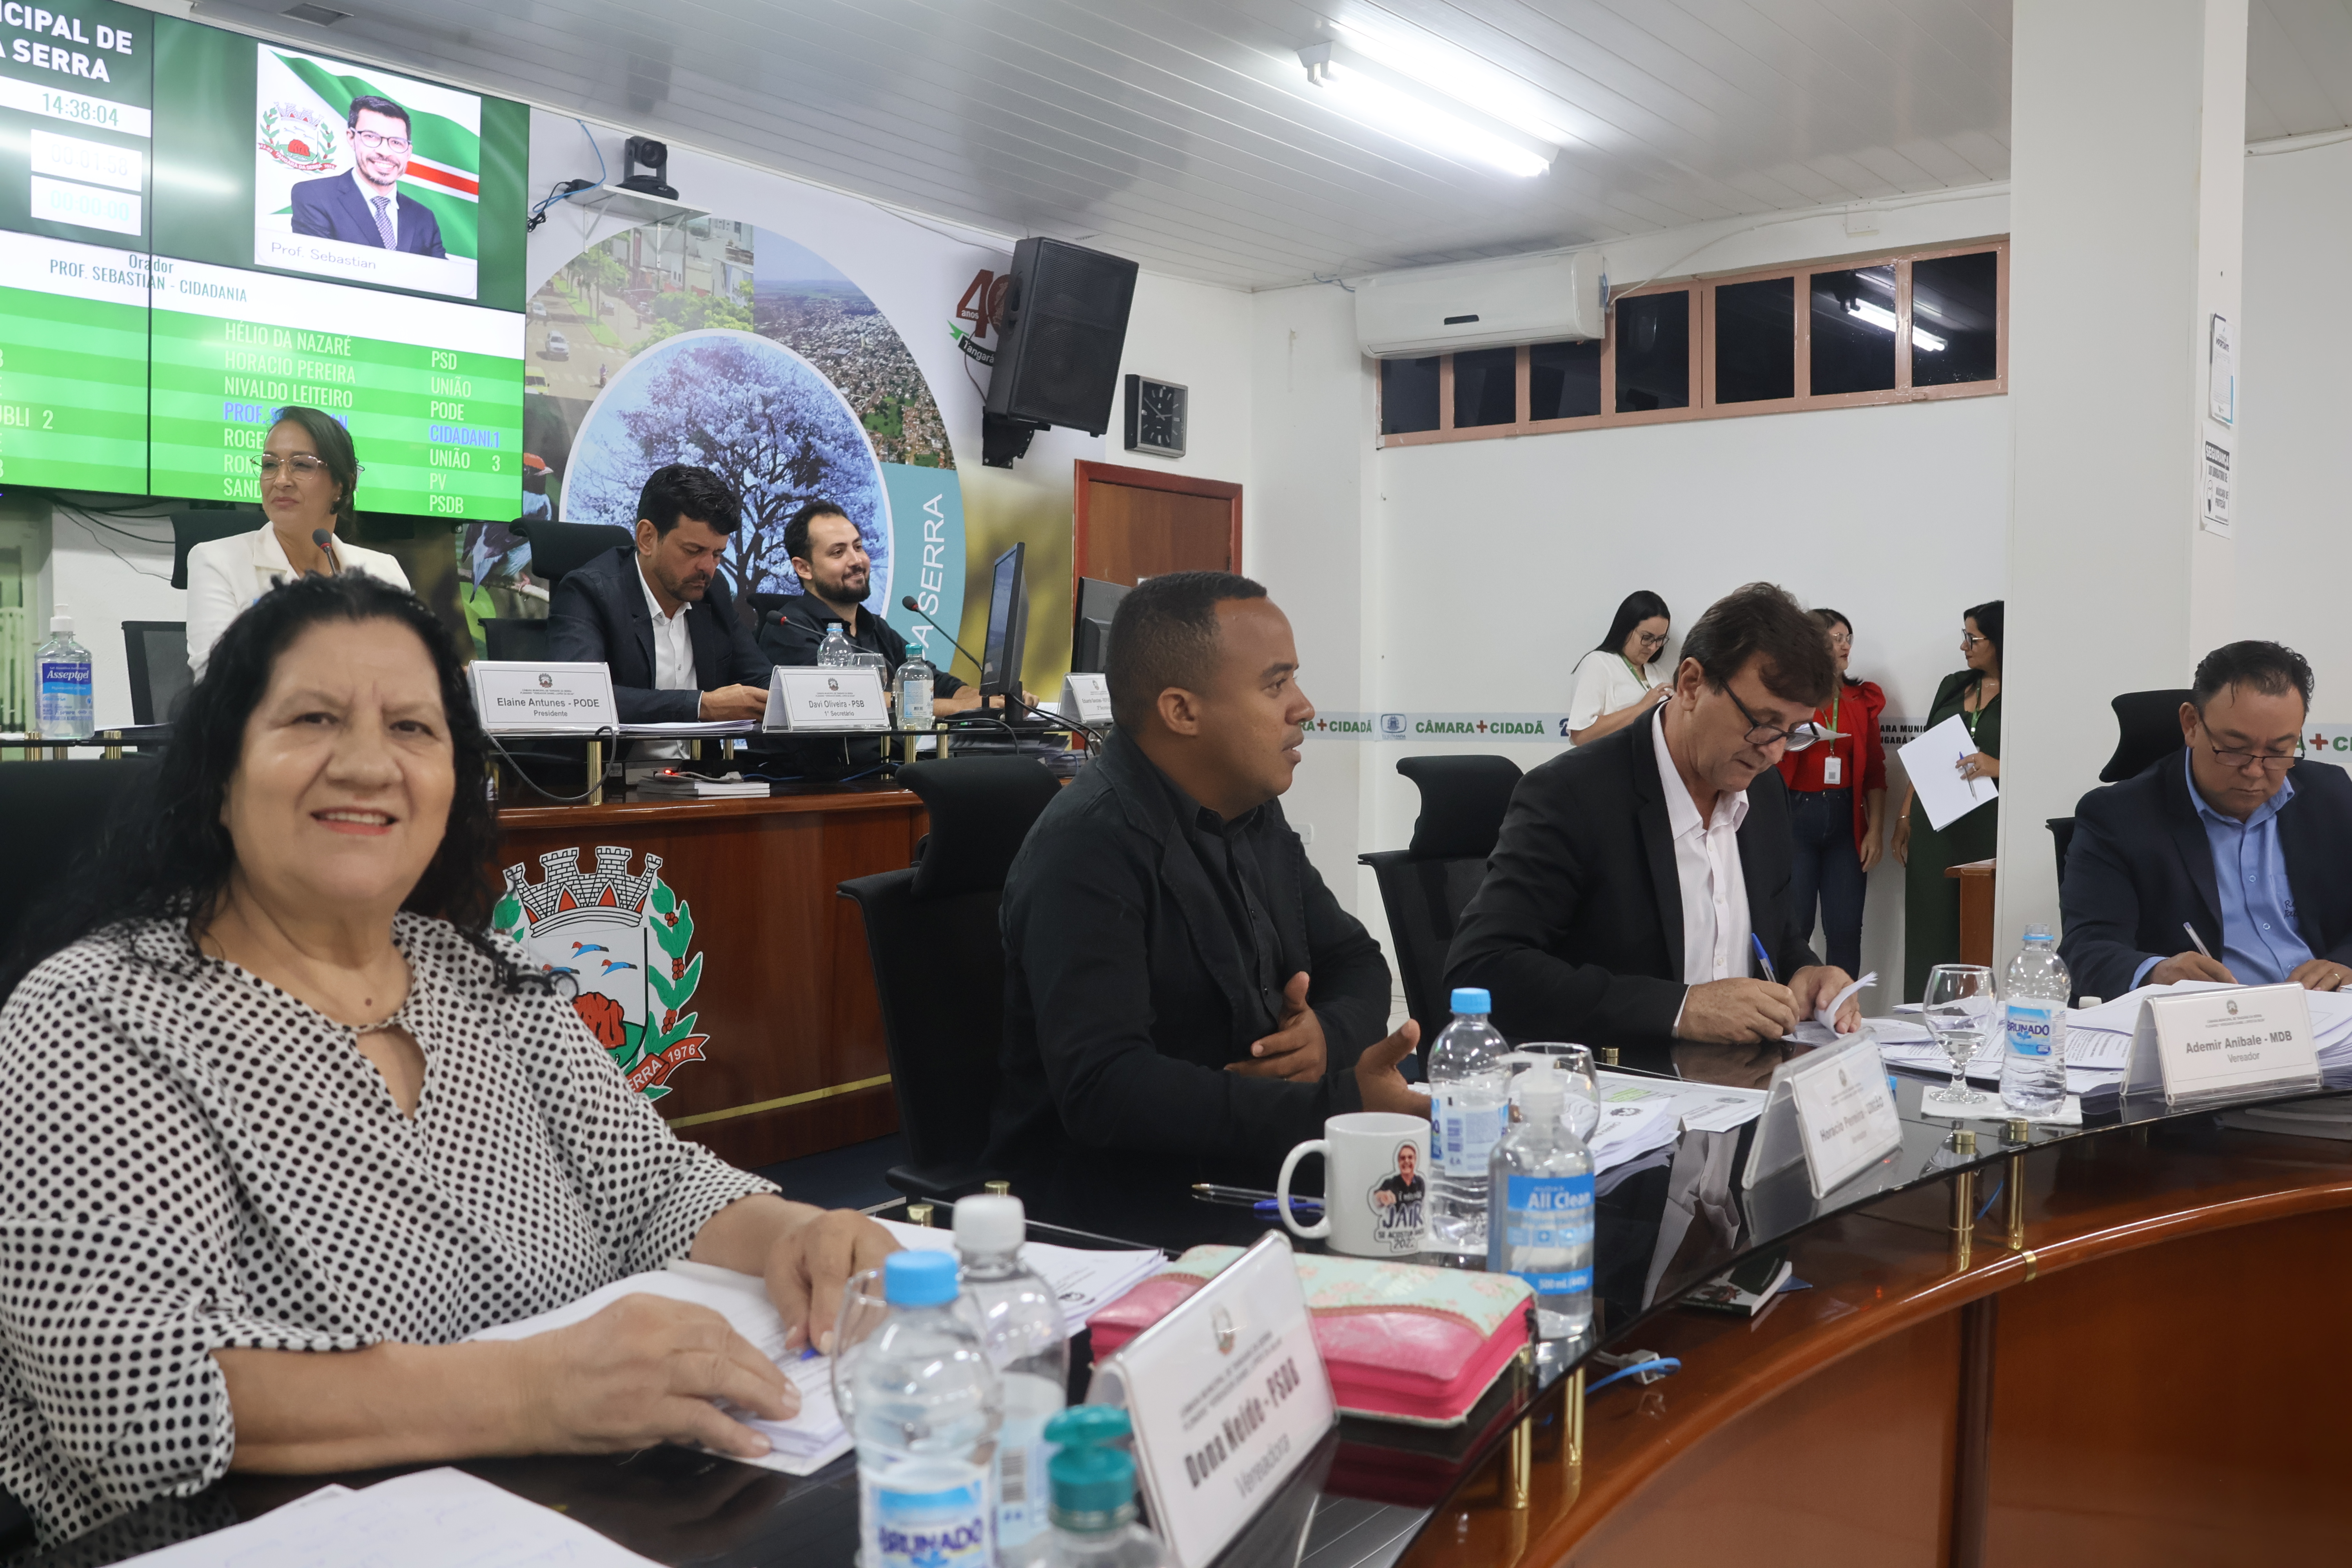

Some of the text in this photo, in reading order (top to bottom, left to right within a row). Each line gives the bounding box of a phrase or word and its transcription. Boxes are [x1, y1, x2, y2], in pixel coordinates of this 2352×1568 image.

[0, 1, 132, 54] CIPAL DE
[12, 39, 111, 83] SERRA
[42, 93, 119, 126] 14:38:04
[129, 254, 174, 274] Orador
[271, 241, 376, 269] Prof. Sebastian
[50, 259, 88, 279] PROF.
[93, 266, 165, 290] SEBASTIAN
[180, 279, 247, 303] CIDADANIA
[962, 310, 979, 319] anos
[225, 319, 352, 357] HÉLIO DA NAZARÉ
[431, 350, 457, 370] PSD
[963, 340, 995, 363] Tangará
[225, 350, 356, 384] HORACIO PEREIRA
[224, 376, 353, 408] NIVALDO LEITEIRO
[430, 376, 471, 397] UNIÃO
[0, 405, 54, 430] BLI 2
[223, 401, 266, 424] PROF.
[430, 400, 465, 421] PODE
[224, 428, 267, 450] ROGE
[429, 424, 492, 448] CIDADANI
[430, 447, 501, 472] UNIÃO 3
[223, 477, 263, 499] SAND
[430, 472, 446, 491] PV
[429, 494, 464, 514] PSDB
[917, 493, 945, 615] SERRA
[47, 670, 89, 681] Asseptgel
[497, 697, 526, 707] Elaine
[529, 698, 566, 707] Antunes
[573, 699, 600, 707] PODE
[1329, 719, 1372, 733] CIDADÃ
[1416, 719, 1475, 733] CÂMARA
[1490, 720, 1545, 734] CIDADÃ
[2007, 1020, 2049, 1036] BRUNADO
[2186, 1039, 2222, 1053] Ademir
[2225, 1034, 2262, 1049] Anibale
[2269, 1030, 2292, 1043] MDB
[668, 1044, 695, 1063] 1976
[2227, 1052, 2260, 1063] Vereador
[1528, 1191, 1591, 1209] All Clean
[1382, 1202, 1423, 1229] JAIR
[1185, 1436, 1227, 1488] Dona
[1222, 1397, 1265, 1450] Neide
[1266, 1356, 1301, 1408] PSDB
